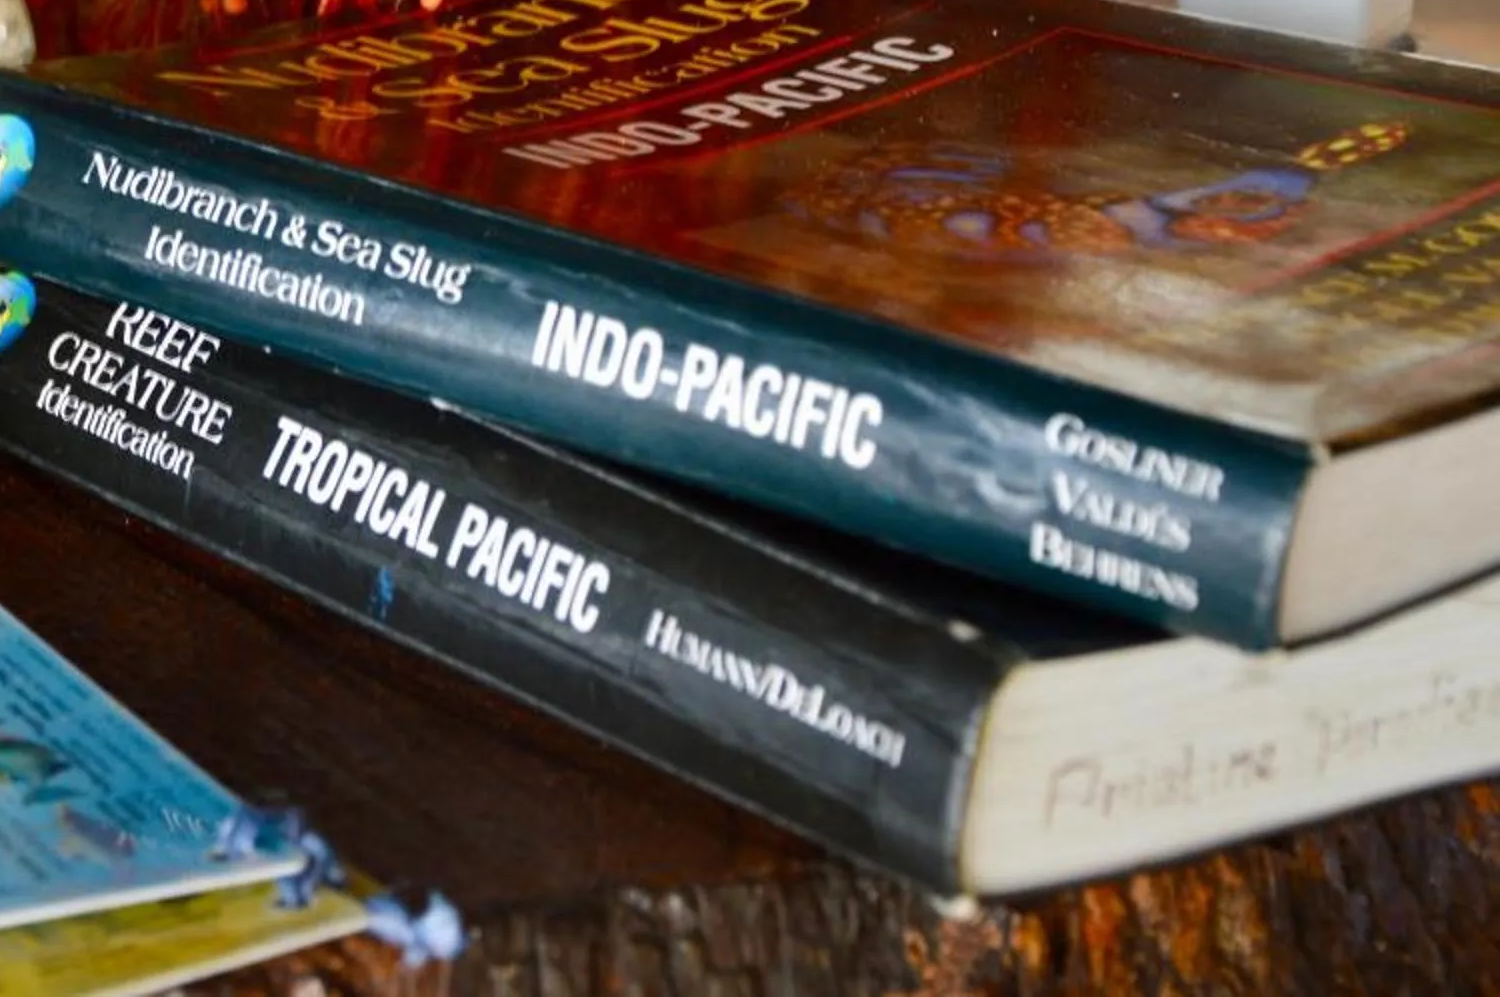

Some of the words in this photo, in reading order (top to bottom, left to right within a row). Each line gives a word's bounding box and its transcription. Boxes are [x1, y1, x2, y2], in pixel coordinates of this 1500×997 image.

[502, 35, 956, 171] INDO-PACIFIC
[82, 152, 279, 241] Nudibranch
[281, 215, 307, 249] &
[311, 220, 382, 271] Sea
[384, 244, 473, 305] Slug
[145, 225, 368, 327] Identification
[47, 331, 235, 446] CREATURE
[105, 302, 222, 375] REEF
[531, 300, 885, 471] INDO-PACIFIC
[35, 378, 198, 482] Identification
[263, 416, 448, 561] TROPICAL
[446, 503, 611, 634] PACIFIC
